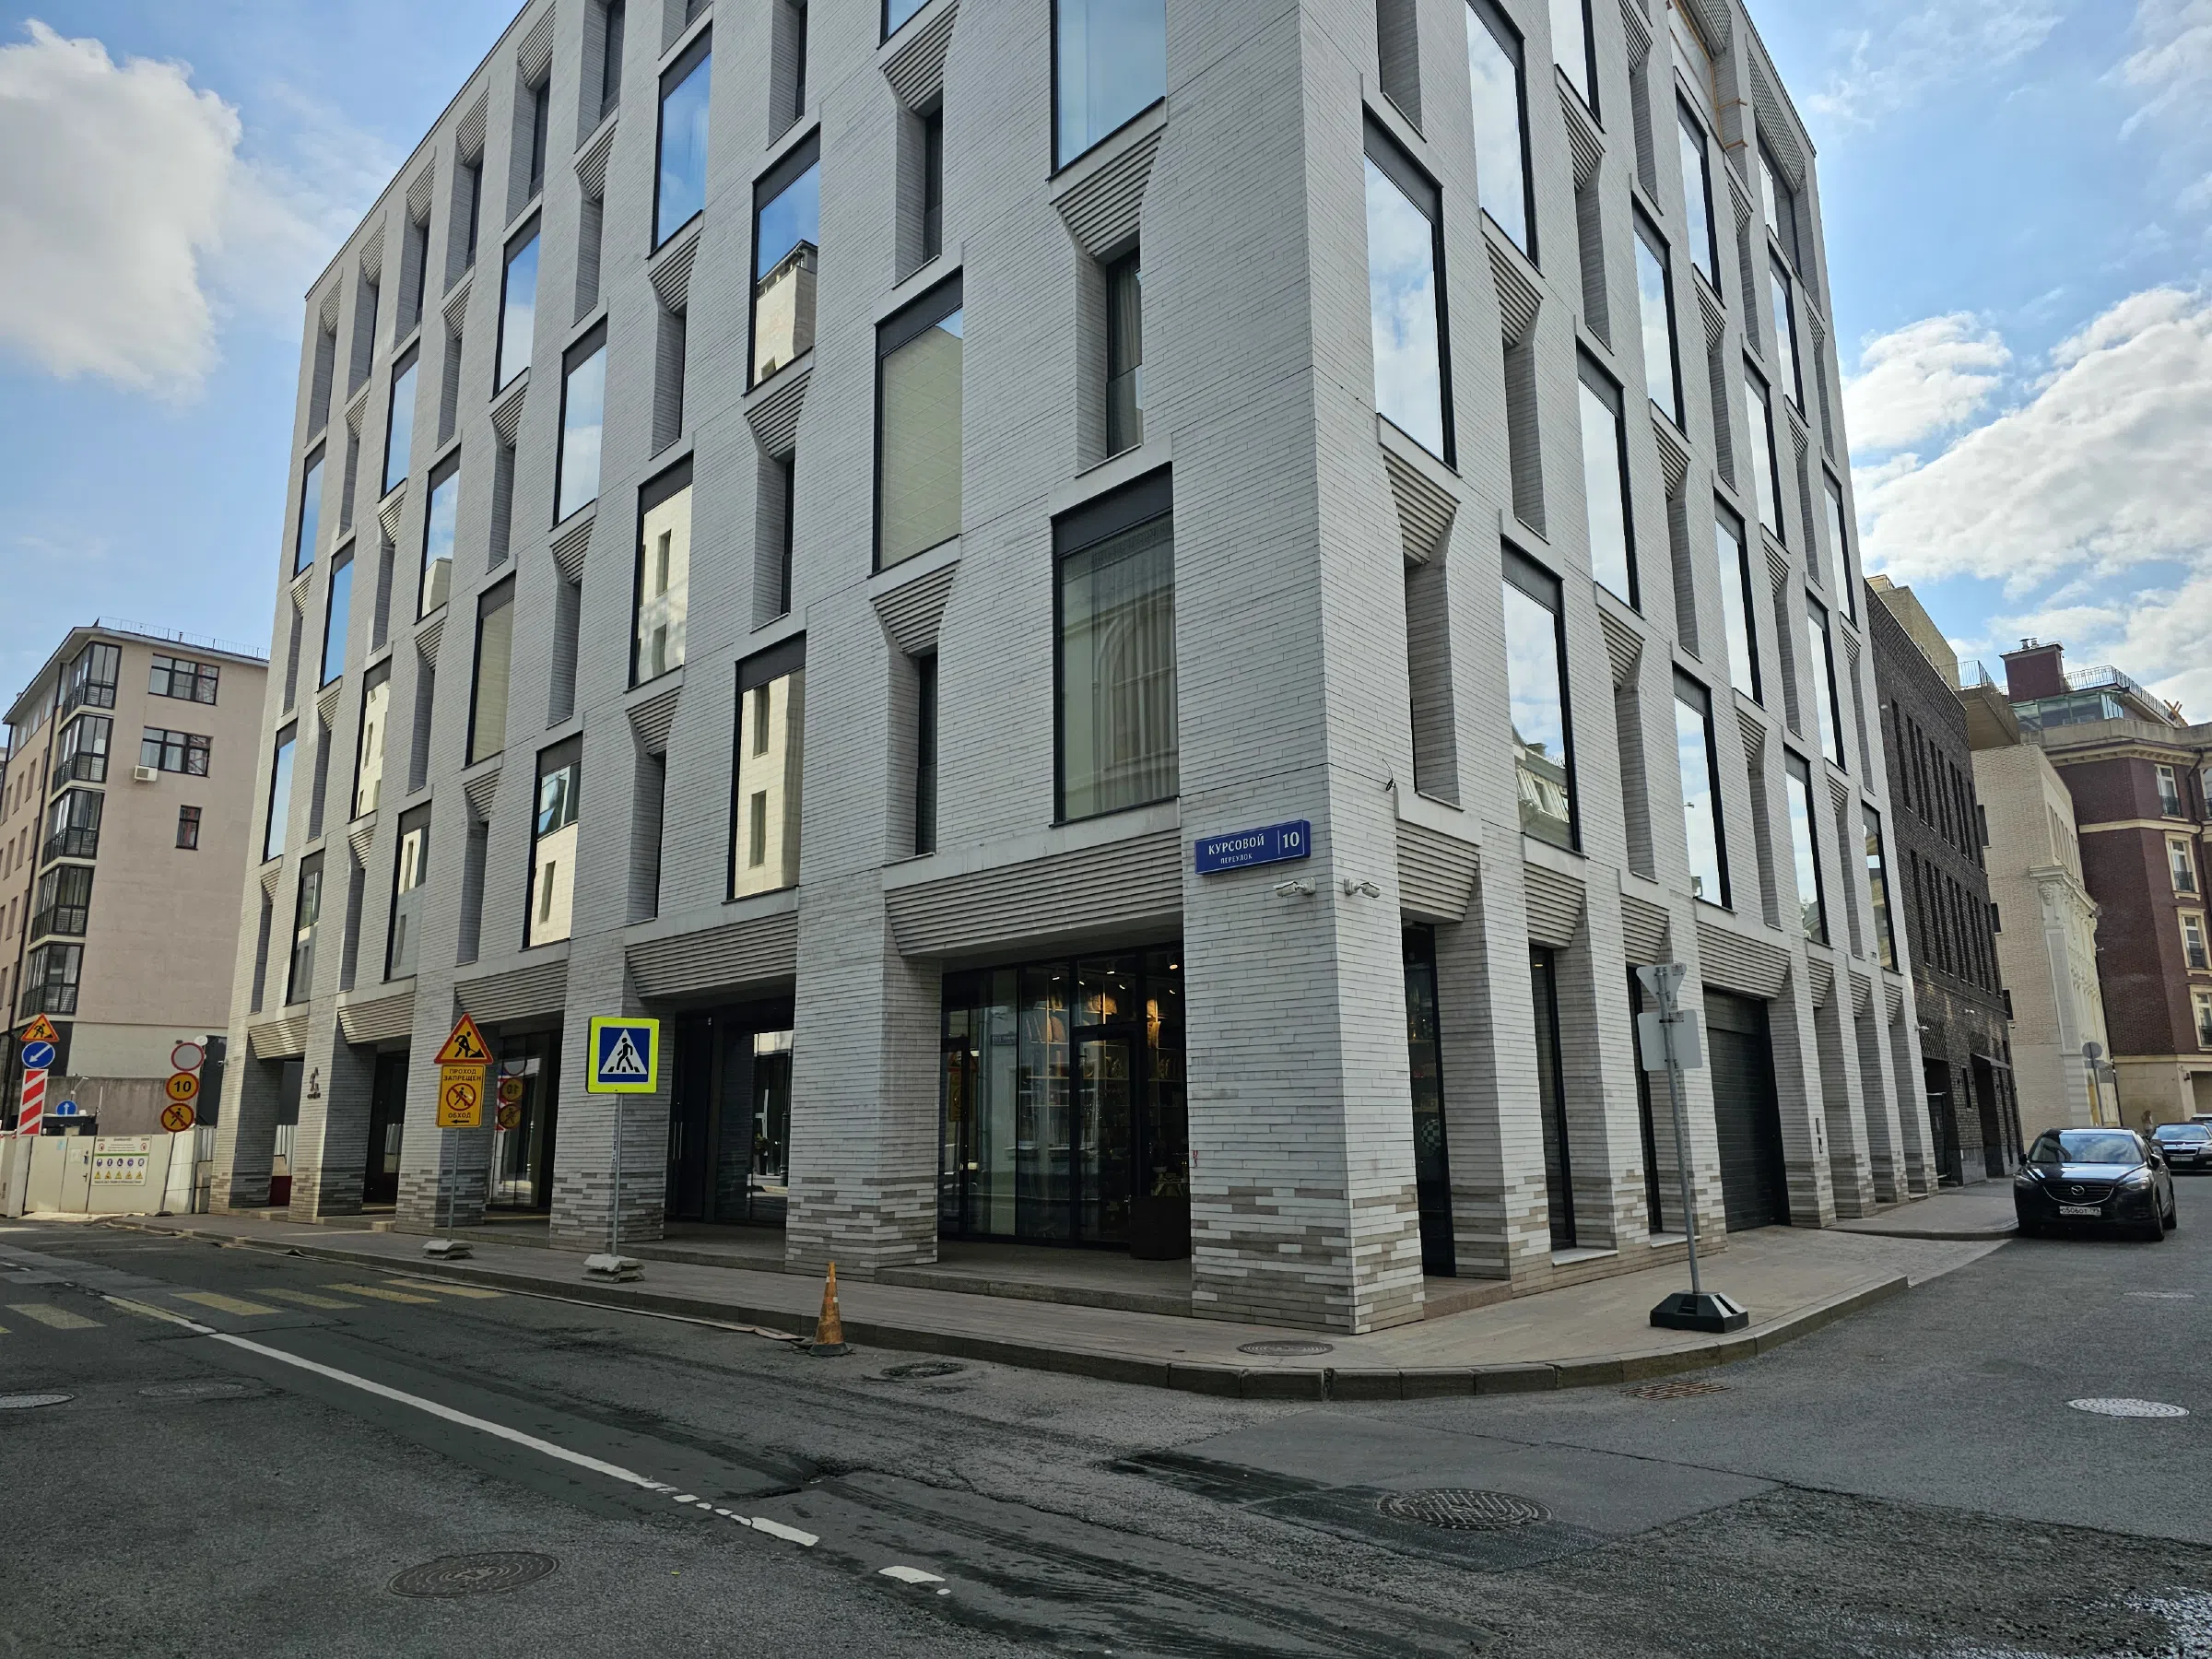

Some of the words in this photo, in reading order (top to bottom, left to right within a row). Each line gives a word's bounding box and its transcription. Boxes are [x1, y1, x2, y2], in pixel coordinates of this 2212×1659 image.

[1208, 833, 1265, 855] КУРСОВОЙ
[1282, 831, 1300, 848] 10
[1220, 853, 1253, 865] ПЕРЕУЛОК
[173, 1080, 192, 1093] 10
